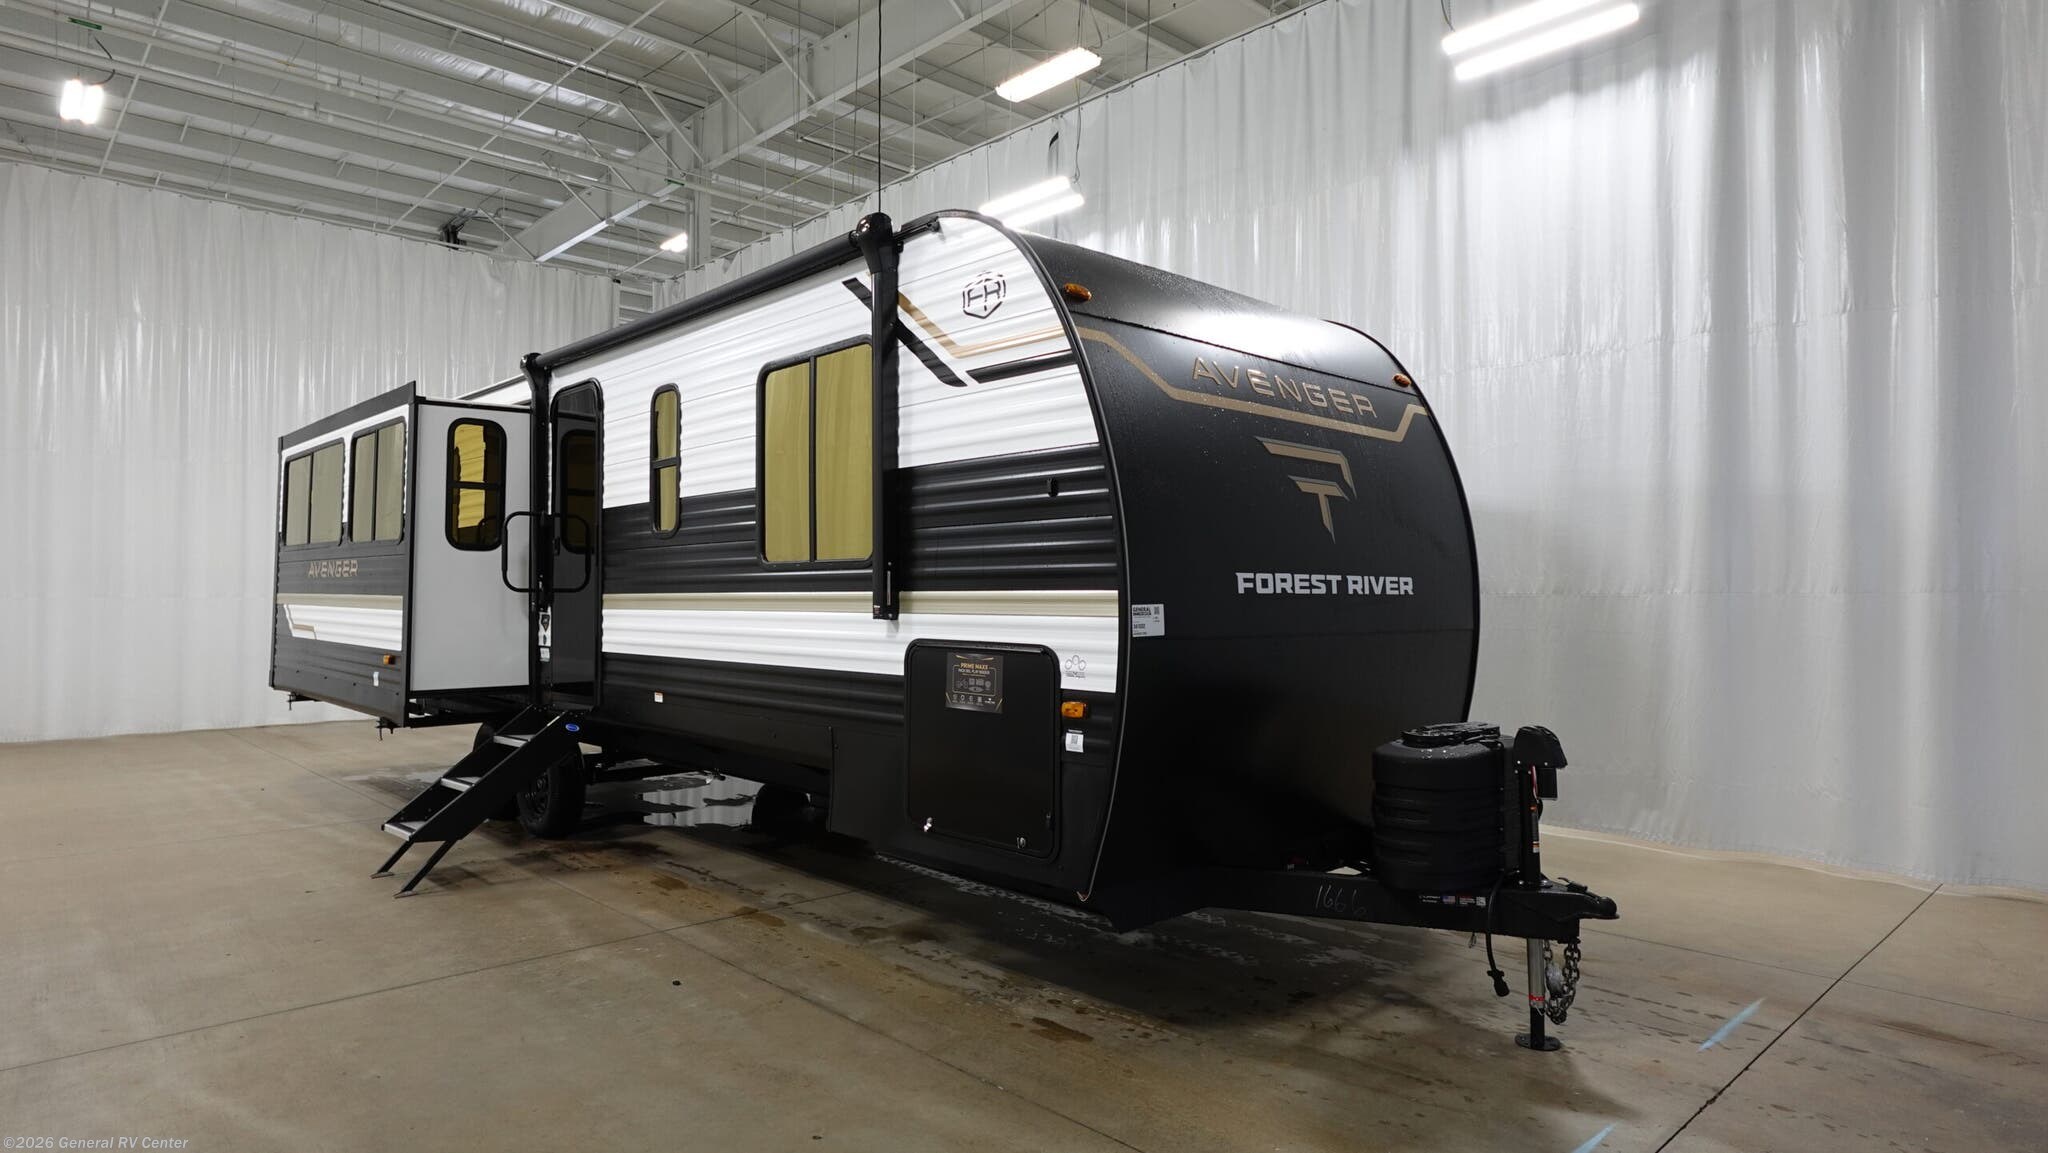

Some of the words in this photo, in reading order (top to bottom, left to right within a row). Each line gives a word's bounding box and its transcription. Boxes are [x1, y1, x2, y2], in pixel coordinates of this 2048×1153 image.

[1192, 357, 1378, 418] AVENGER
[308, 560, 358, 578] AVENGER
[1235, 572, 1342, 594] FOREST
[1346, 575, 1414, 595] RIVER
